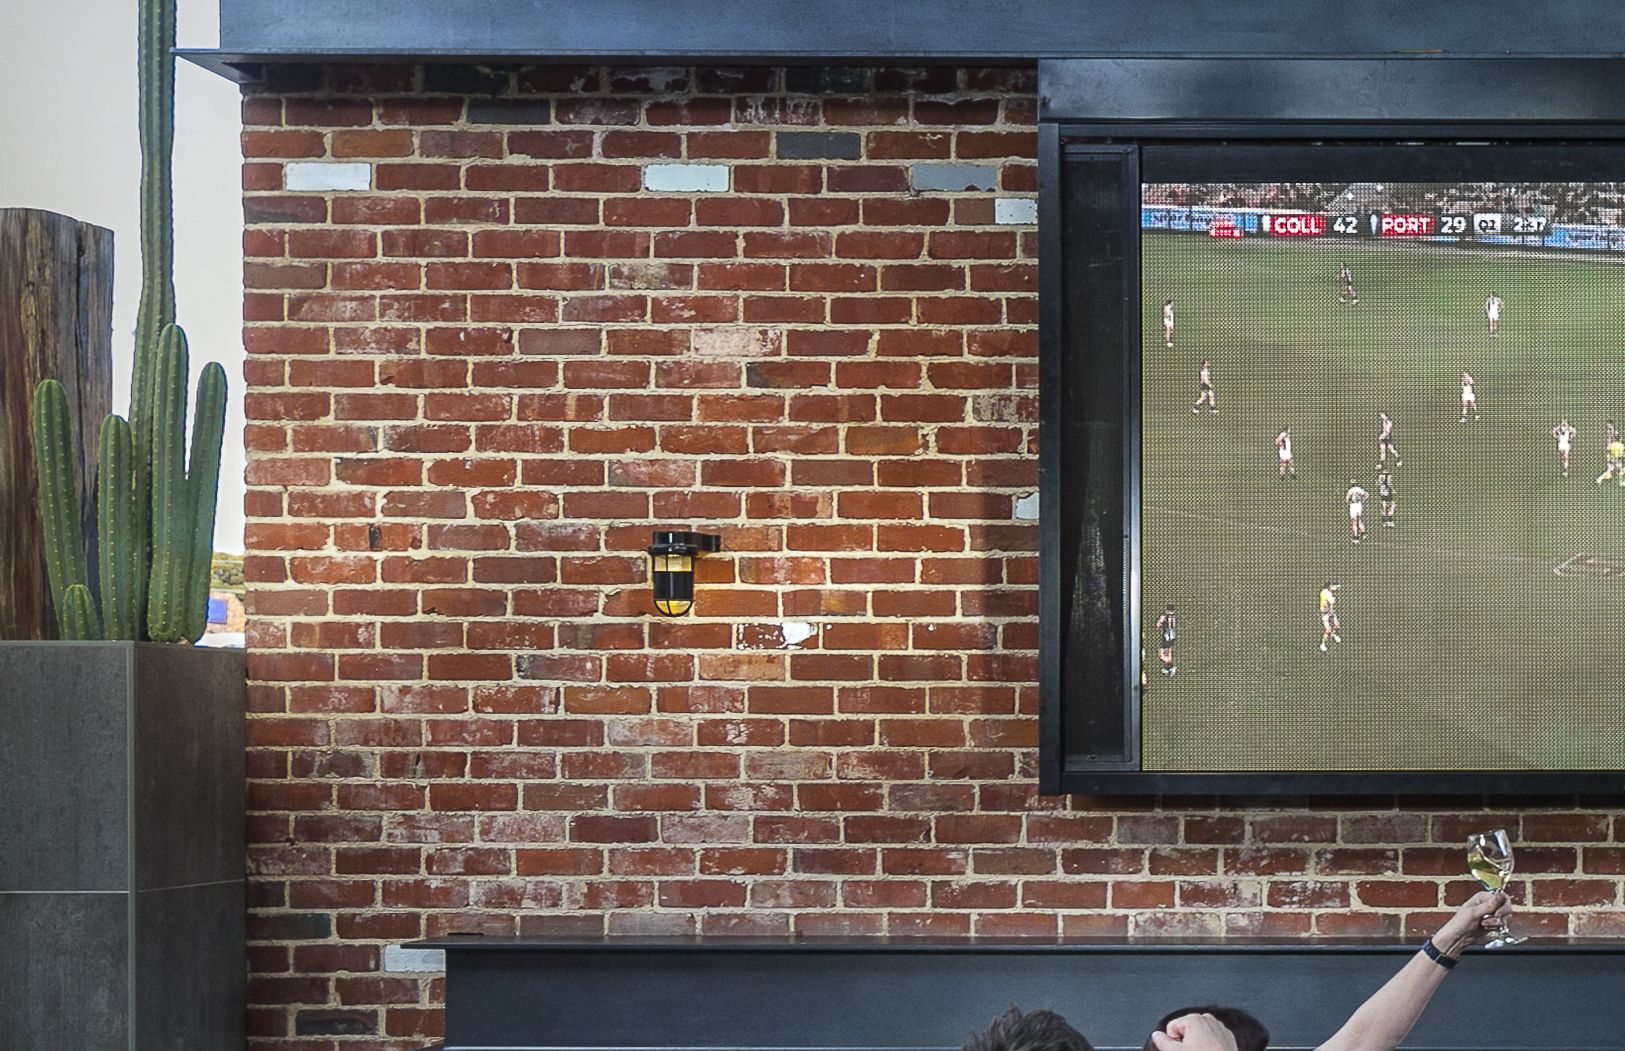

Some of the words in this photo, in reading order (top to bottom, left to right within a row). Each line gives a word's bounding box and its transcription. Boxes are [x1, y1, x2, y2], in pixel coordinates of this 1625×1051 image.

[1274, 217, 1321, 233] COLL
[1333, 216, 1358, 233] 42
[1381, 217, 1431, 233] PORT
[1440, 216, 1467, 233] 29
